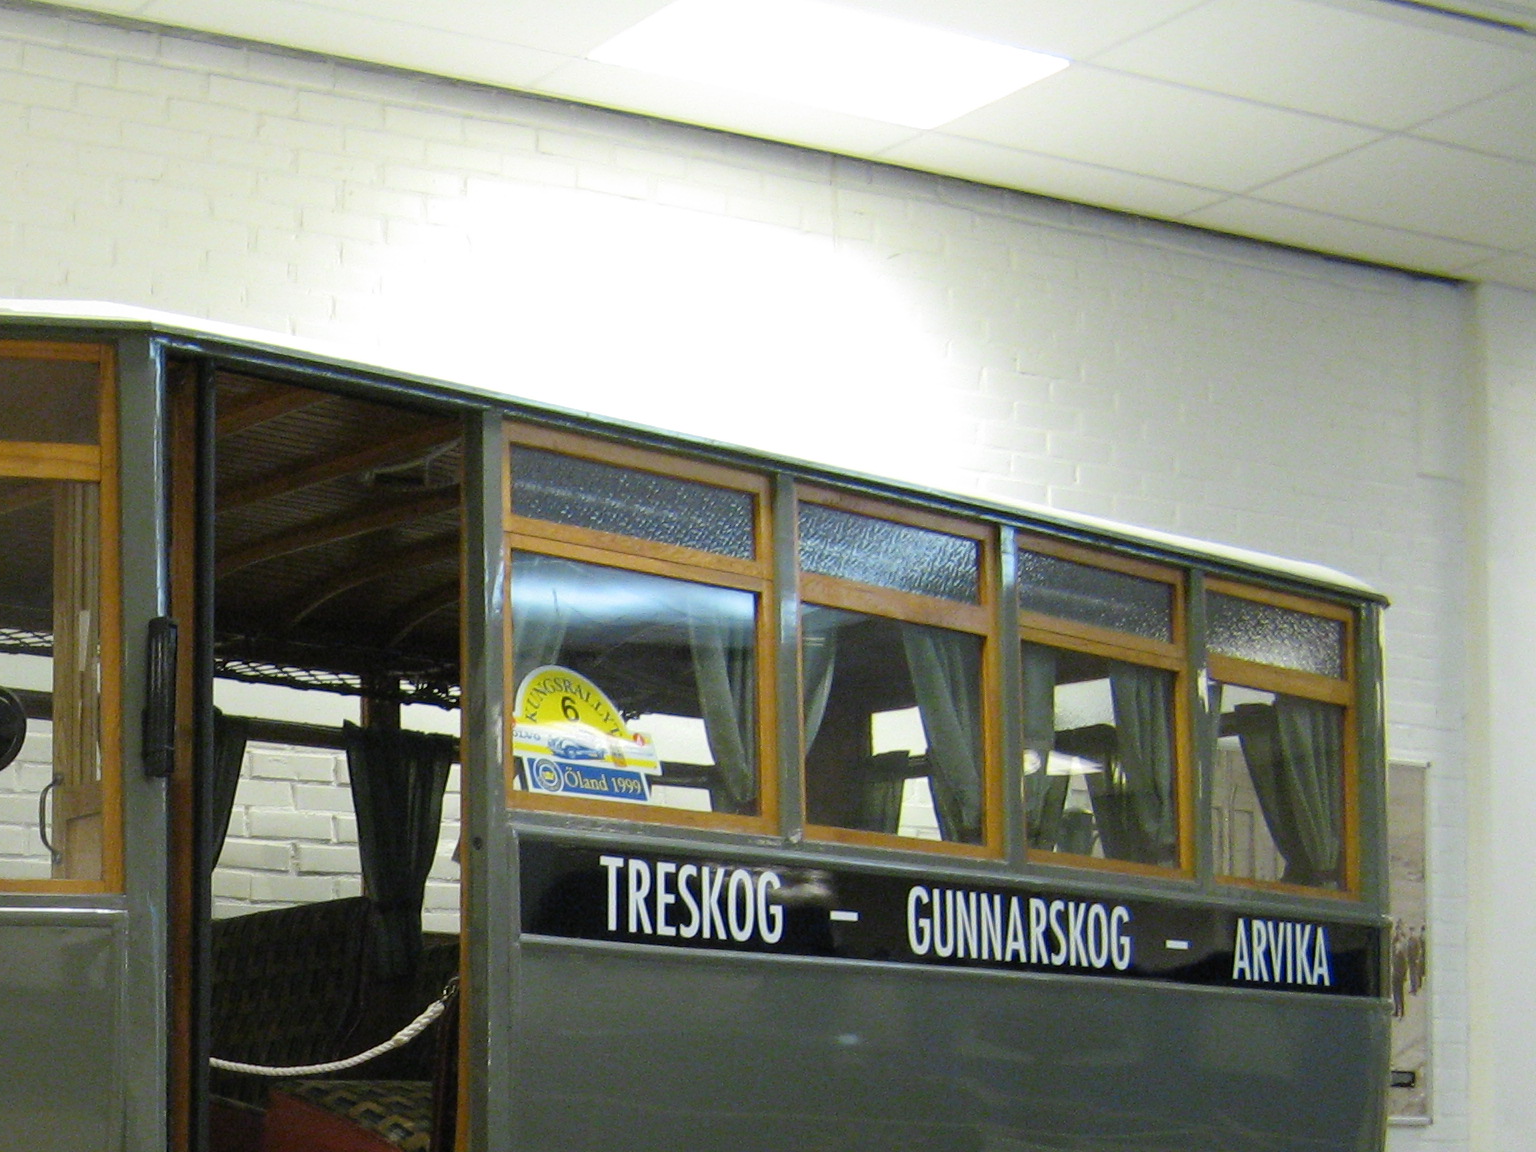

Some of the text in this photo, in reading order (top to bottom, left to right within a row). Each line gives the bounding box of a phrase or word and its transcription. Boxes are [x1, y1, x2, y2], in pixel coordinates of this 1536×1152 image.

[560, 696, 580, 723] 6
[565, 766, 609, 792] Öland
[612, 777, 642, 794] 1999
[599, 855, 785, 945] TRESKOG
[907, 886, 1132, 971] GUNNARSKOG
[1232, 917, 1331, 987] ARVIKA
